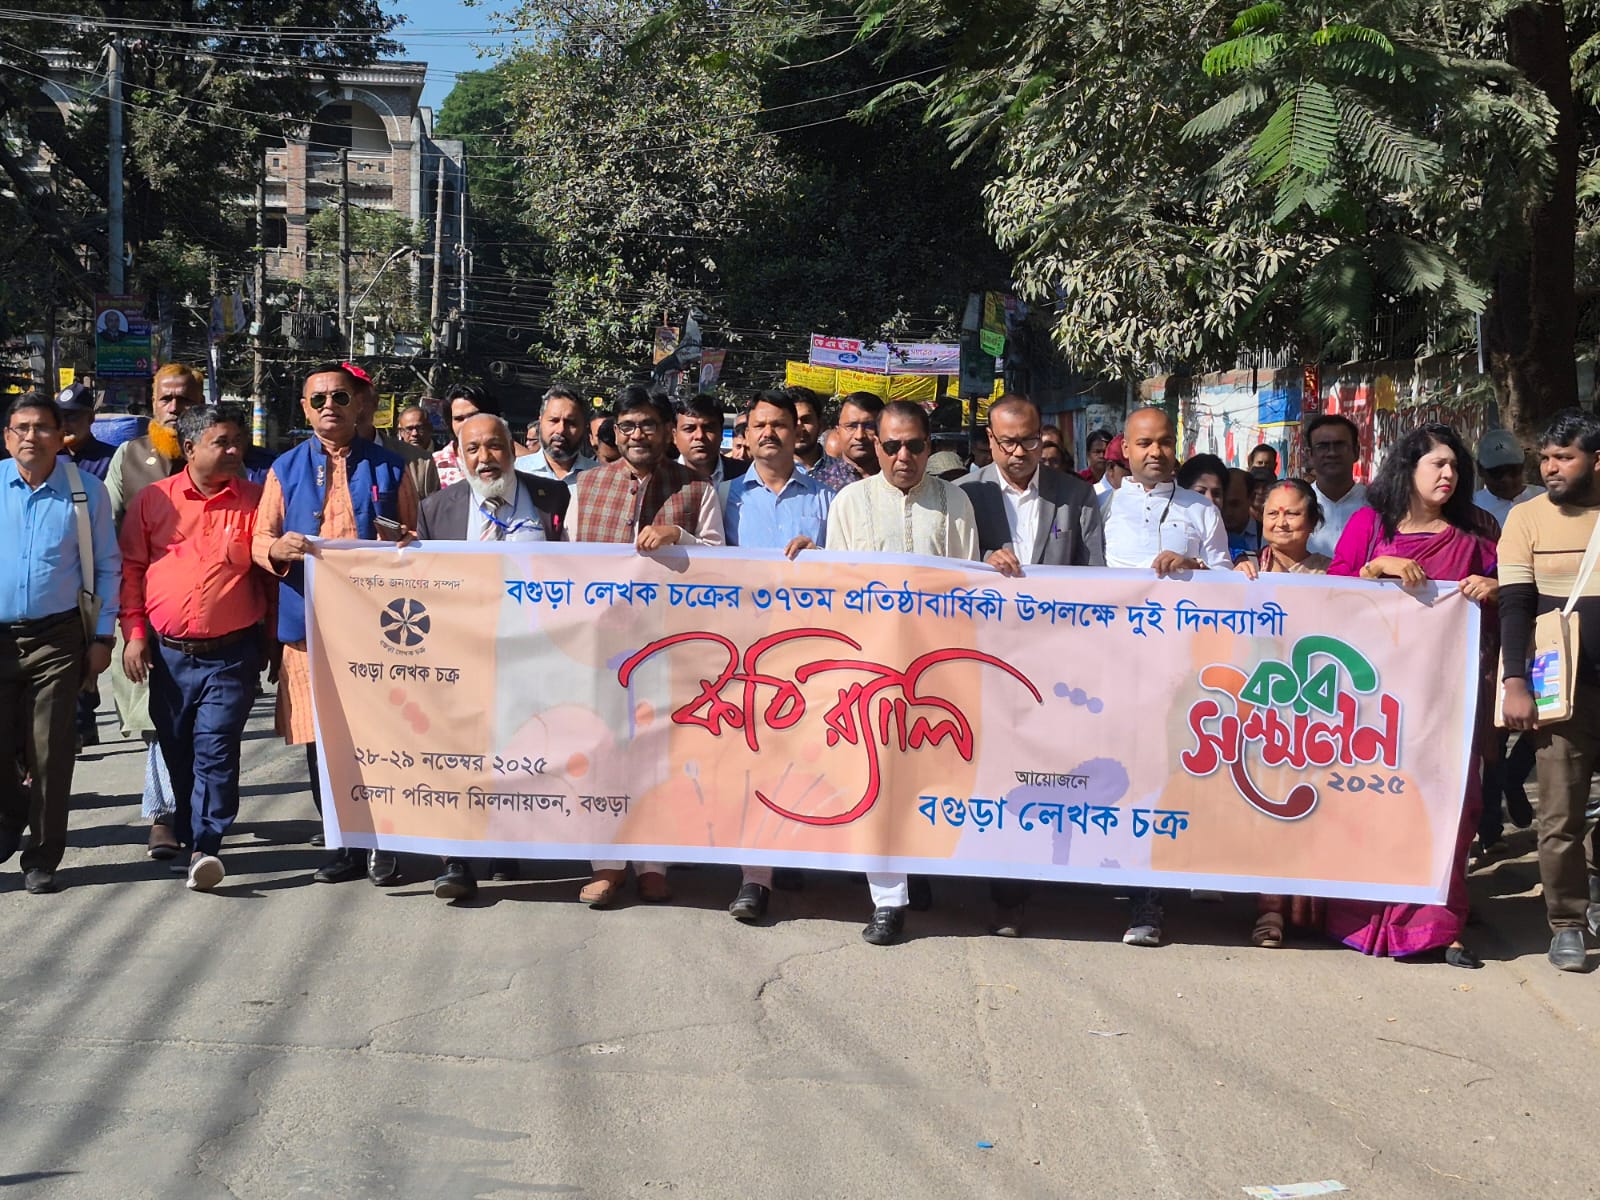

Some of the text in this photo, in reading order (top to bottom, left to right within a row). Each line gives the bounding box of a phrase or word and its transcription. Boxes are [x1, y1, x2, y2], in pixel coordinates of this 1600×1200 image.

[389, 577, 429, 589] জনগণের
[504, 578, 1288, 638] বগুড়া লেখক চক্রের ৩৭তম প্রতিষ্ঠাবার্ষিকী উপলক্ষে দুই দিনব্যাপী
[348, 661, 460, 684] বগুড়া লেখক চক্র
[1238, 634, 1379, 716] কবি
[1181, 664, 1401, 820] সম্মেলন
[354, 747, 548, 776] ২৮-২৯ নভেম্বর ২০২৫
[1015, 770, 1090, 790] আয়োজনে
[1327, 772, 1405, 795] ২০২৫
[351, 783, 631, 817] জেলা পরিষদ মিলনায়তন, বগুড়া
[918, 795, 1190, 840] বগুড়া লেখক চক্র
